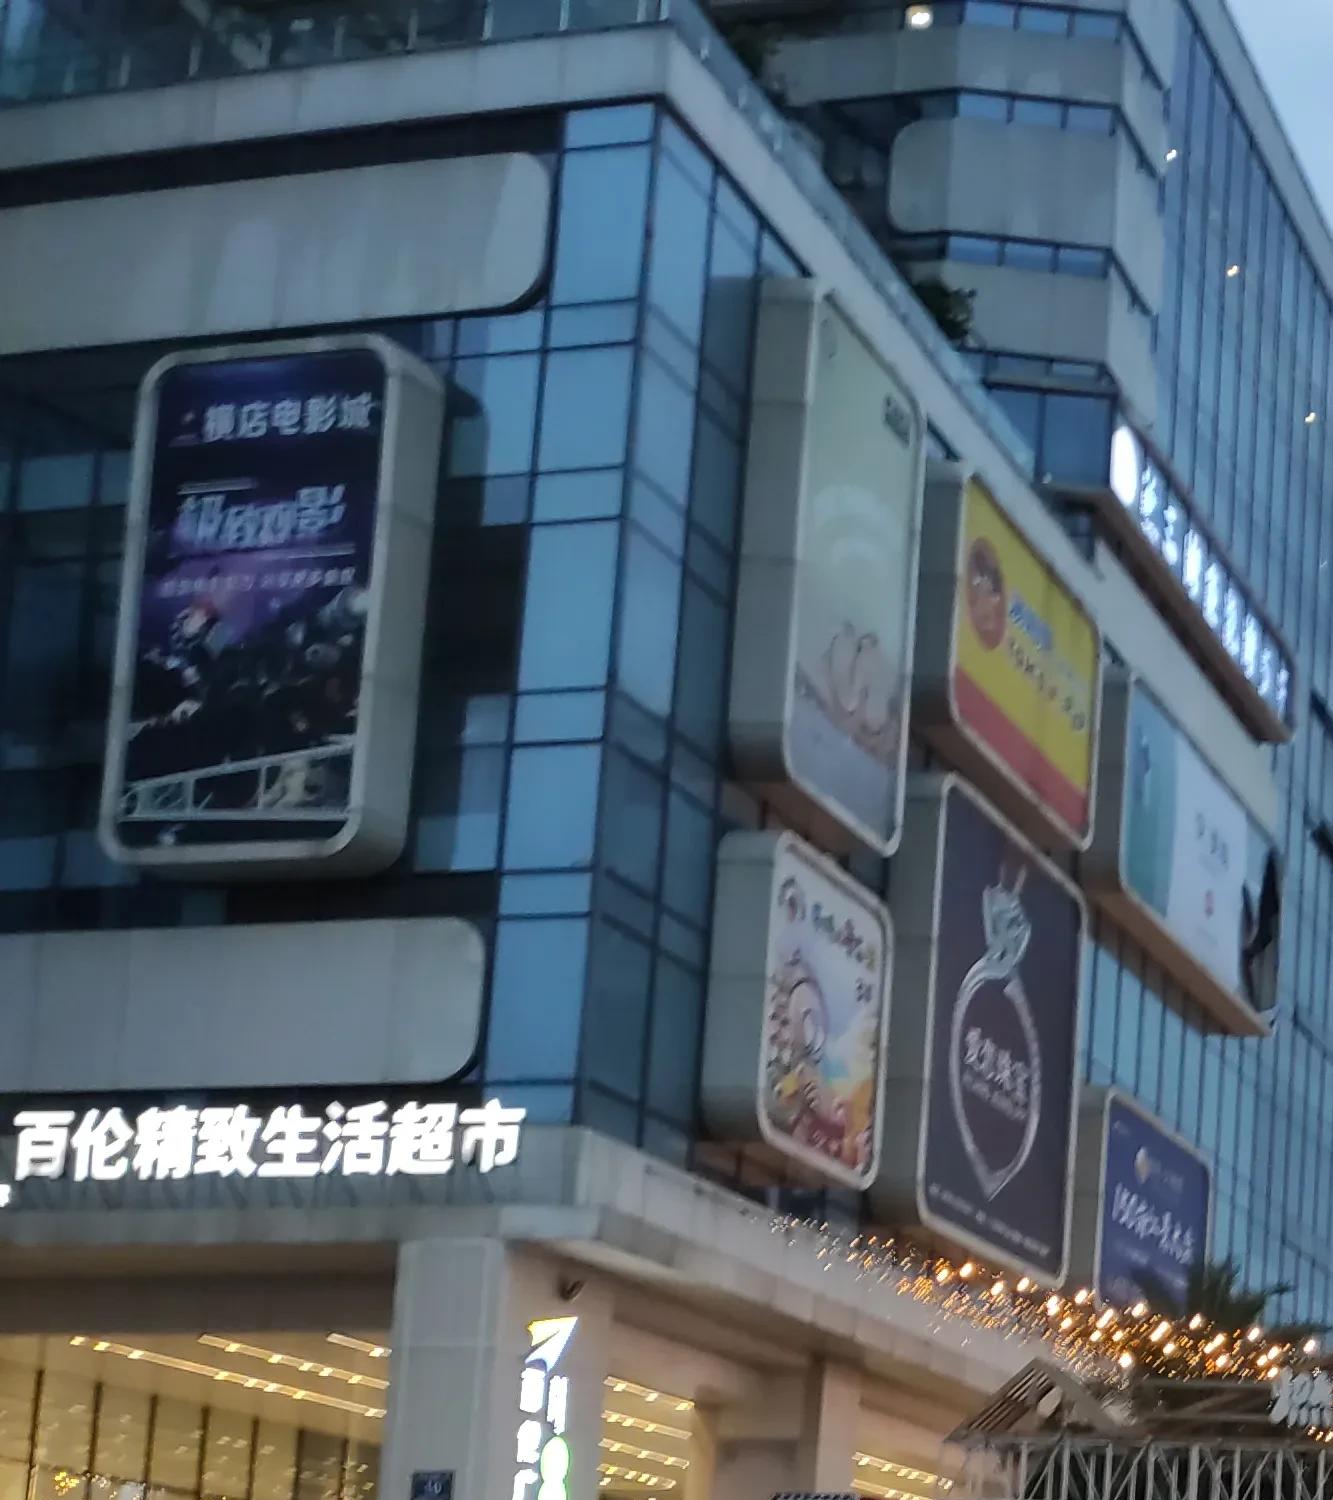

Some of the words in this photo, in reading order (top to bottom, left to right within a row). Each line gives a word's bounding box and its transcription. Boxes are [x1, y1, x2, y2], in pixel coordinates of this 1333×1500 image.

[13, 1097, 527, 1182] 百伦精致生活超市
